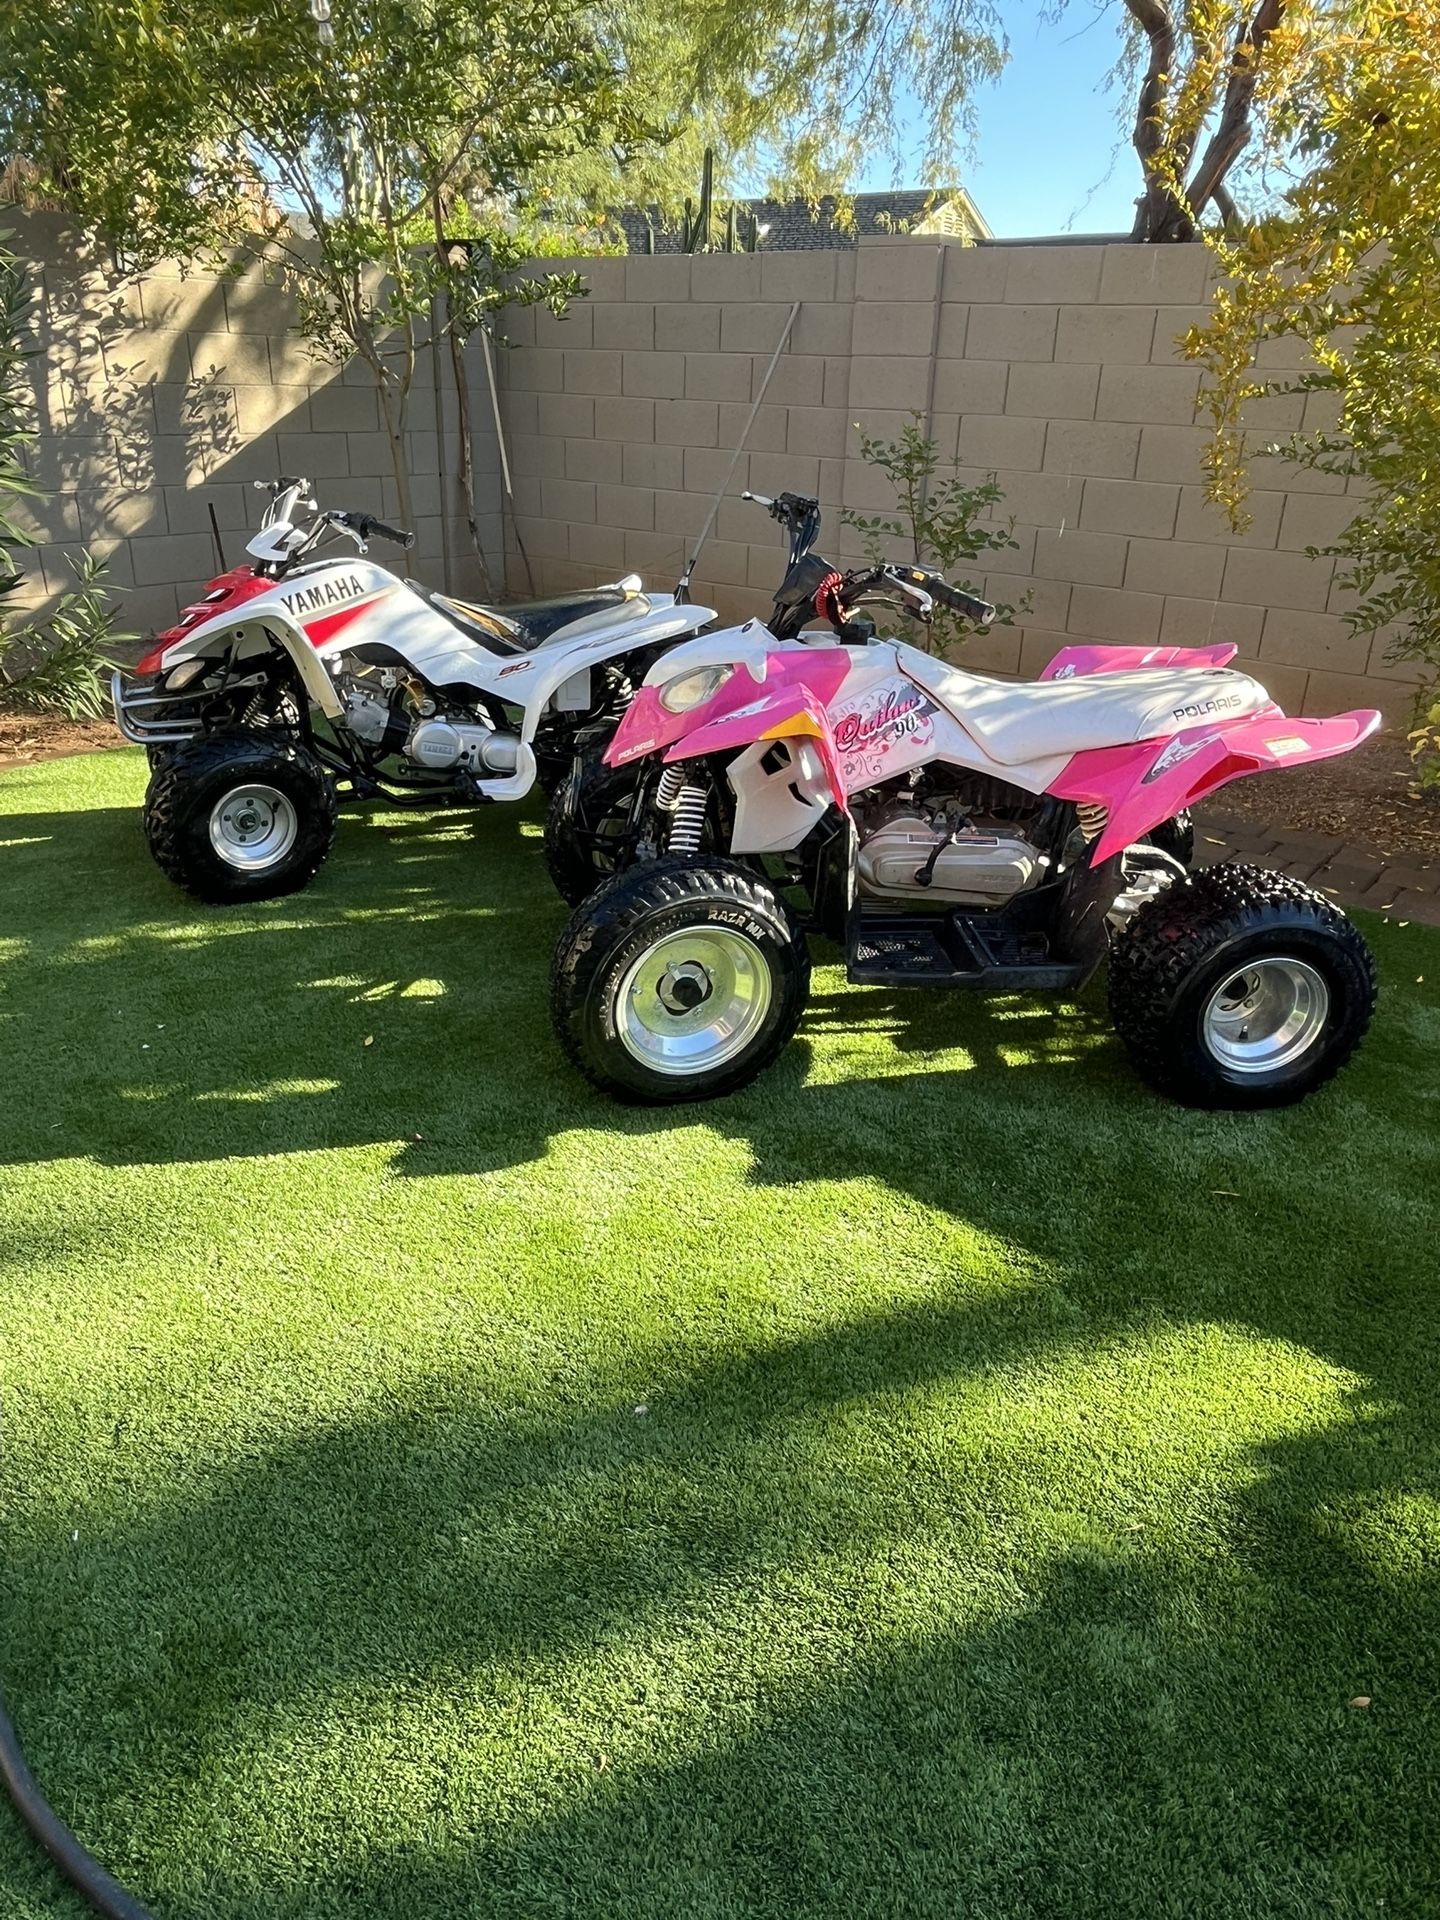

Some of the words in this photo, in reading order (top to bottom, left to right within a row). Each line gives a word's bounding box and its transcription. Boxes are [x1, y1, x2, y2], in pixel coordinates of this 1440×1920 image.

[280, 575, 365, 616] YAMAHA
[1173, 694, 1242, 721] POLARIS
[895, 712, 919, 739] 90
[618, 739, 656, 760] POLARIS
[707, 909, 746, 927] RAZR
[745, 921, 766, 940] MX
